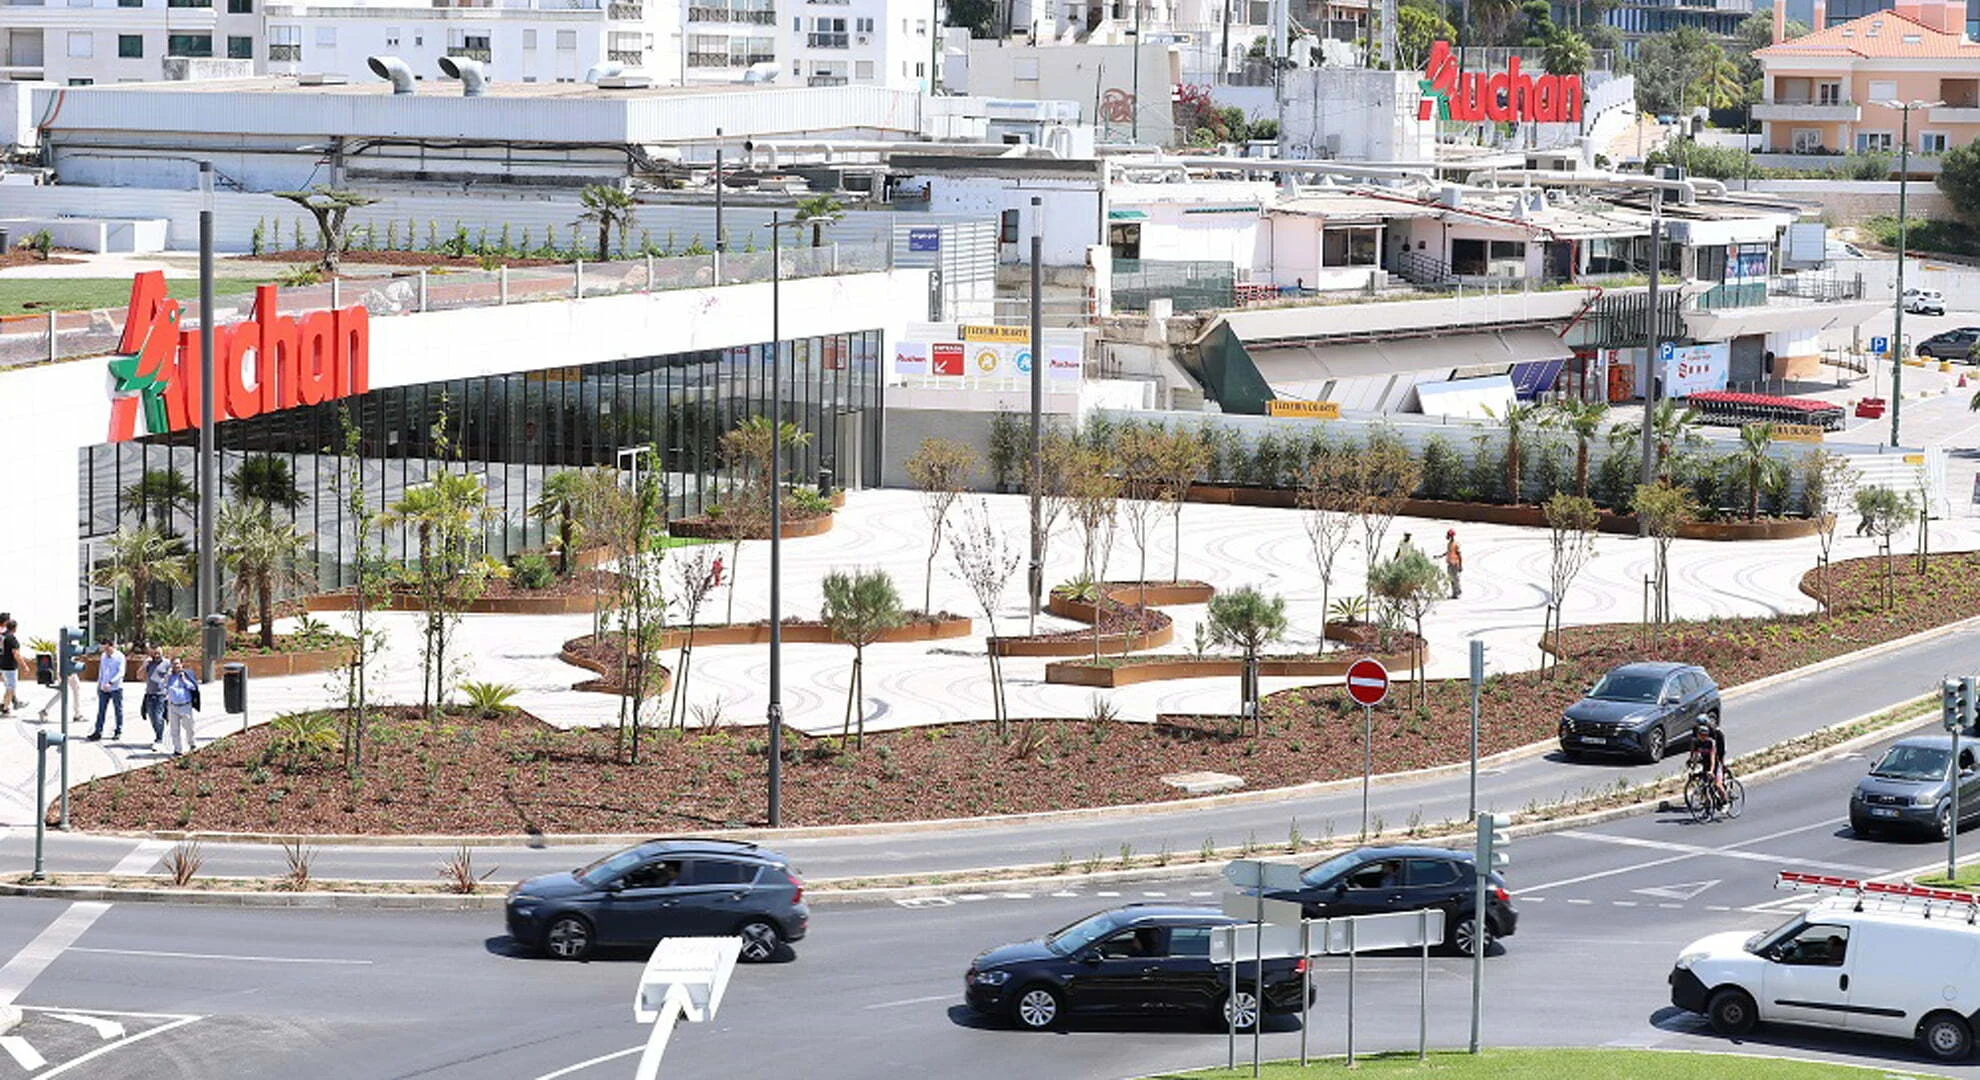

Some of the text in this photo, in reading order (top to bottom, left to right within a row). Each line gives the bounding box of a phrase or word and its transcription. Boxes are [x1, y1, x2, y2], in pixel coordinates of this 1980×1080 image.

[1417, 40, 1583, 123] Auchan
[106, 270, 370, 443] Auchan
[1663, 345, 1672, 360] P
[1875, 338, 1884, 350] P
